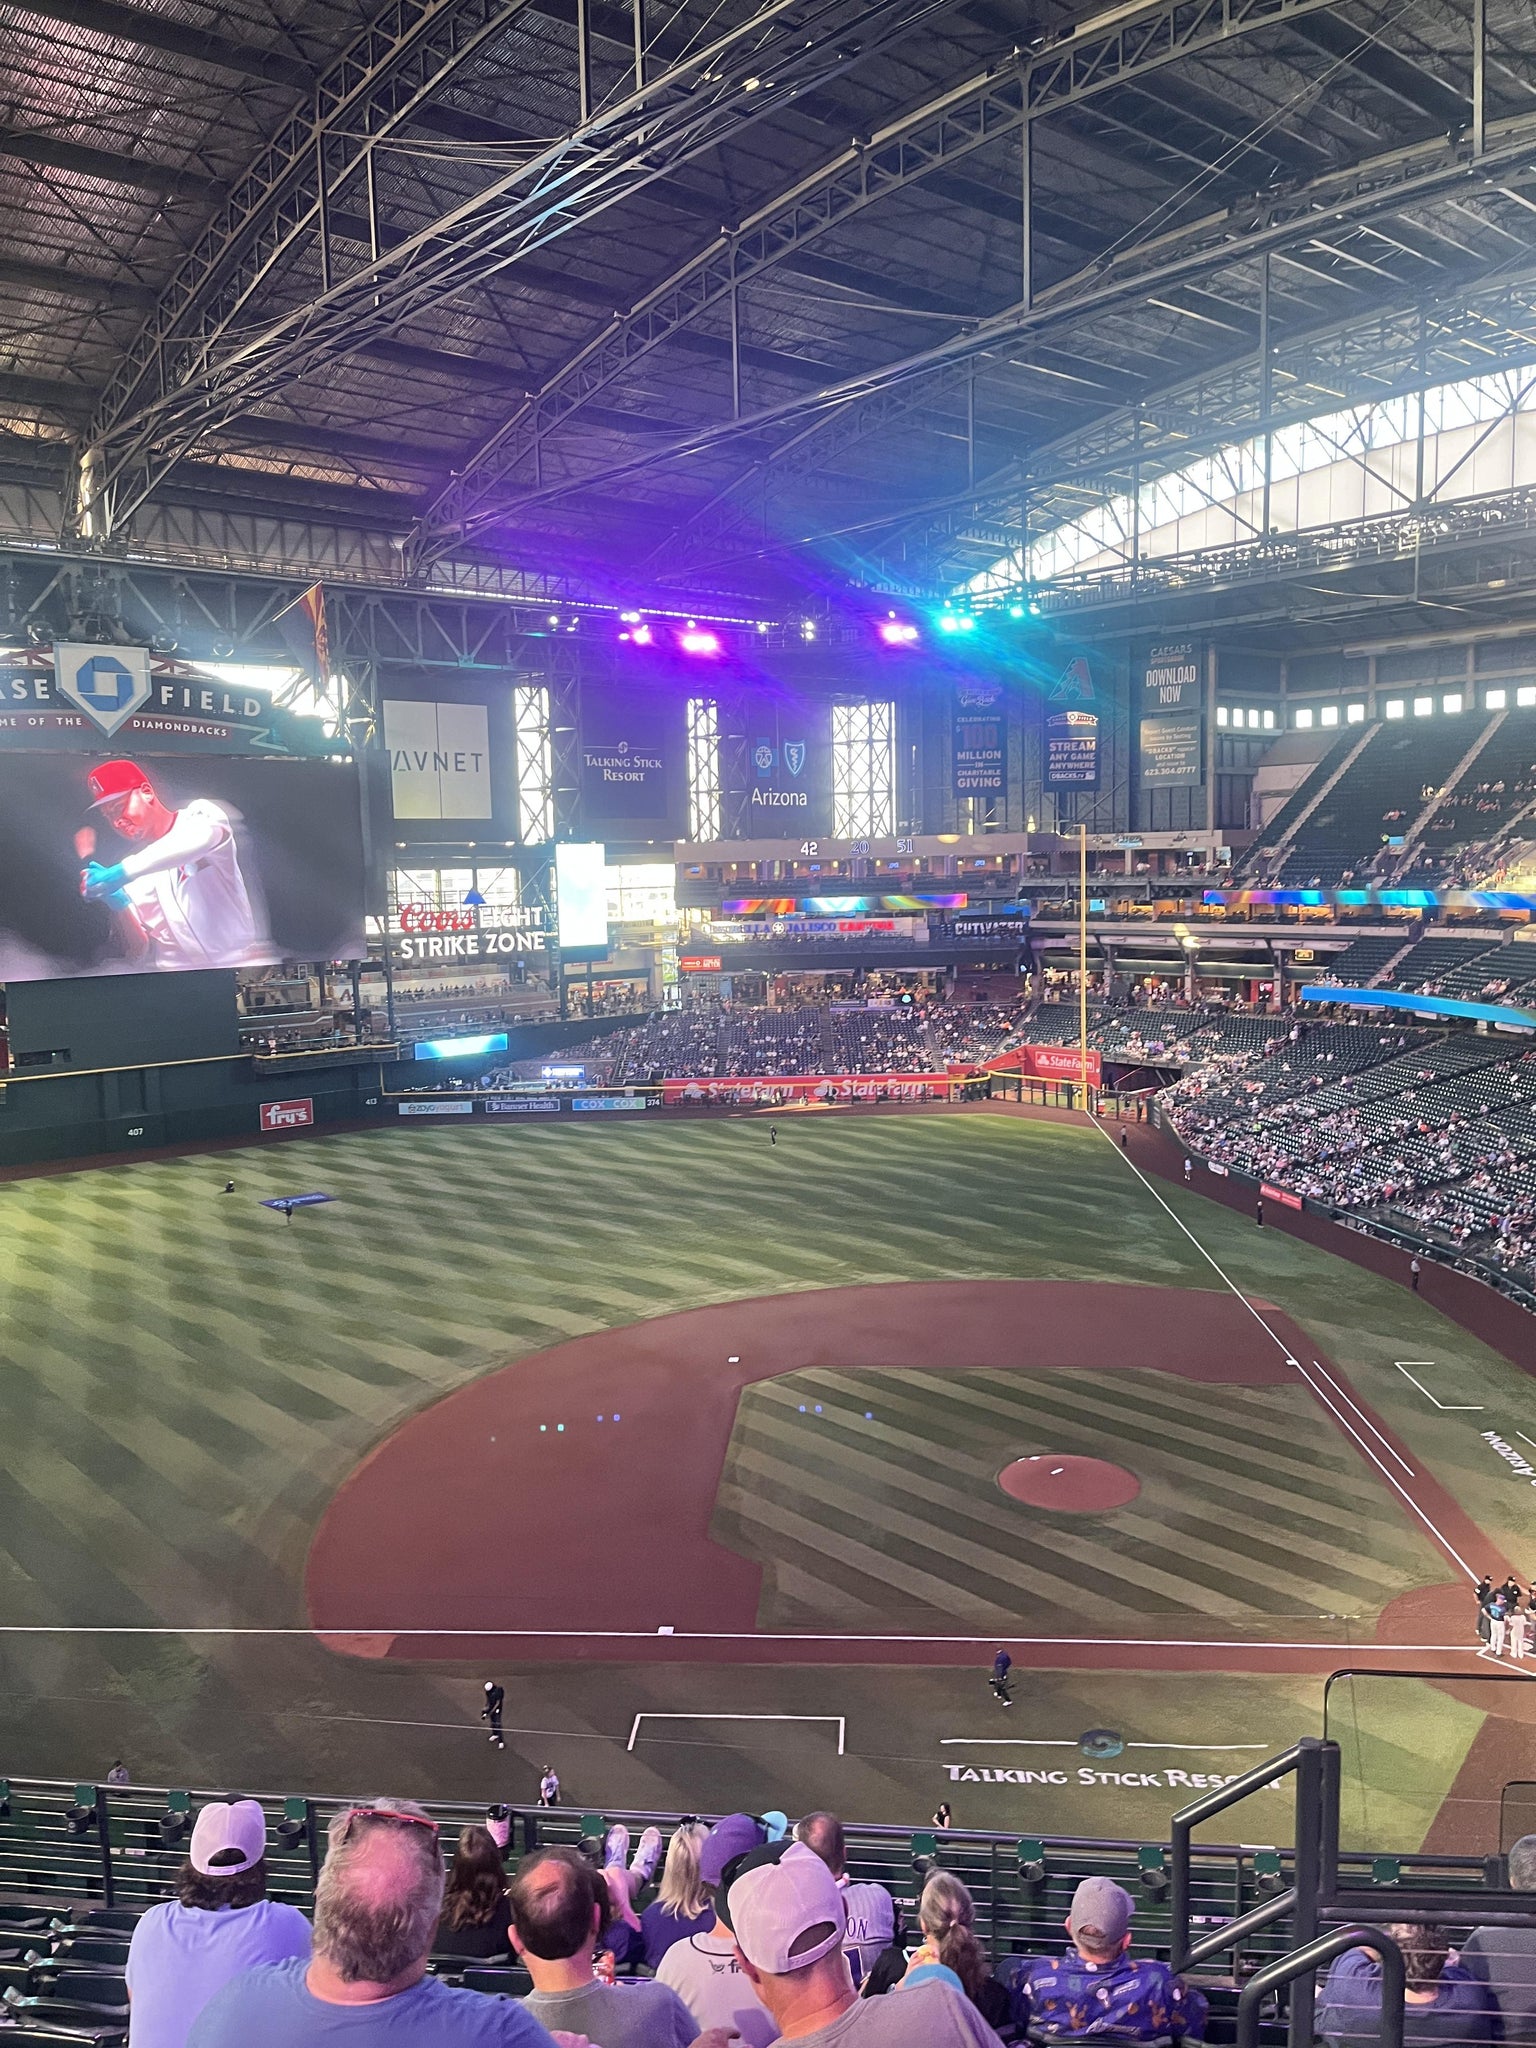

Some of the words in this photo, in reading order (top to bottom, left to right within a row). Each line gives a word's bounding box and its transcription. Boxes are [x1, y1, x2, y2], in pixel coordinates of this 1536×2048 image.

[1151, 644, 1192, 657] CAESARS
[1146, 665, 1196, 687] DOWNLOAD
[0, 679, 50, 699] SE
[161, 685, 262, 717] FIELD
[1160, 685, 1181, 703] NOW
[28, 717, 45, 726] OF
[56, 717, 82, 726] THE
[133, 720, 227, 736] DIAMONDBACKS
[1049, 741, 1096, 751] STREAM
[393, 750, 482, 772] AVNET
[957, 751, 1001, 760] MILLION
[1071, 752, 1096, 760] GAME
[1049, 761, 1096, 770] ANYWHERE
[957, 777, 1002, 788] GIVING
[752, 788, 807, 806] Arizona
[801, 842, 818, 856] 42
[850, 840, 870, 854] 20
[896, 839, 914, 853] 51
[397, 902, 475, 933] Coors
[479, 906, 543, 929] LIGHT
[786, 922, 836, 933] JALISCO
[401, 934, 478, 959] STRIKE
[486, 931, 546, 954] ZONE
[500, 1102, 528, 1110] Banner
[529, 1101, 554, 1109] Health
[581, 1101, 605, 1109] COX
[613, 1100, 637, 1108] COX
[128, 1127, 143, 1136] 407
[942, 1764, 1068, 1785] TALKING
[1078, 1767, 1162, 1788] STICK
